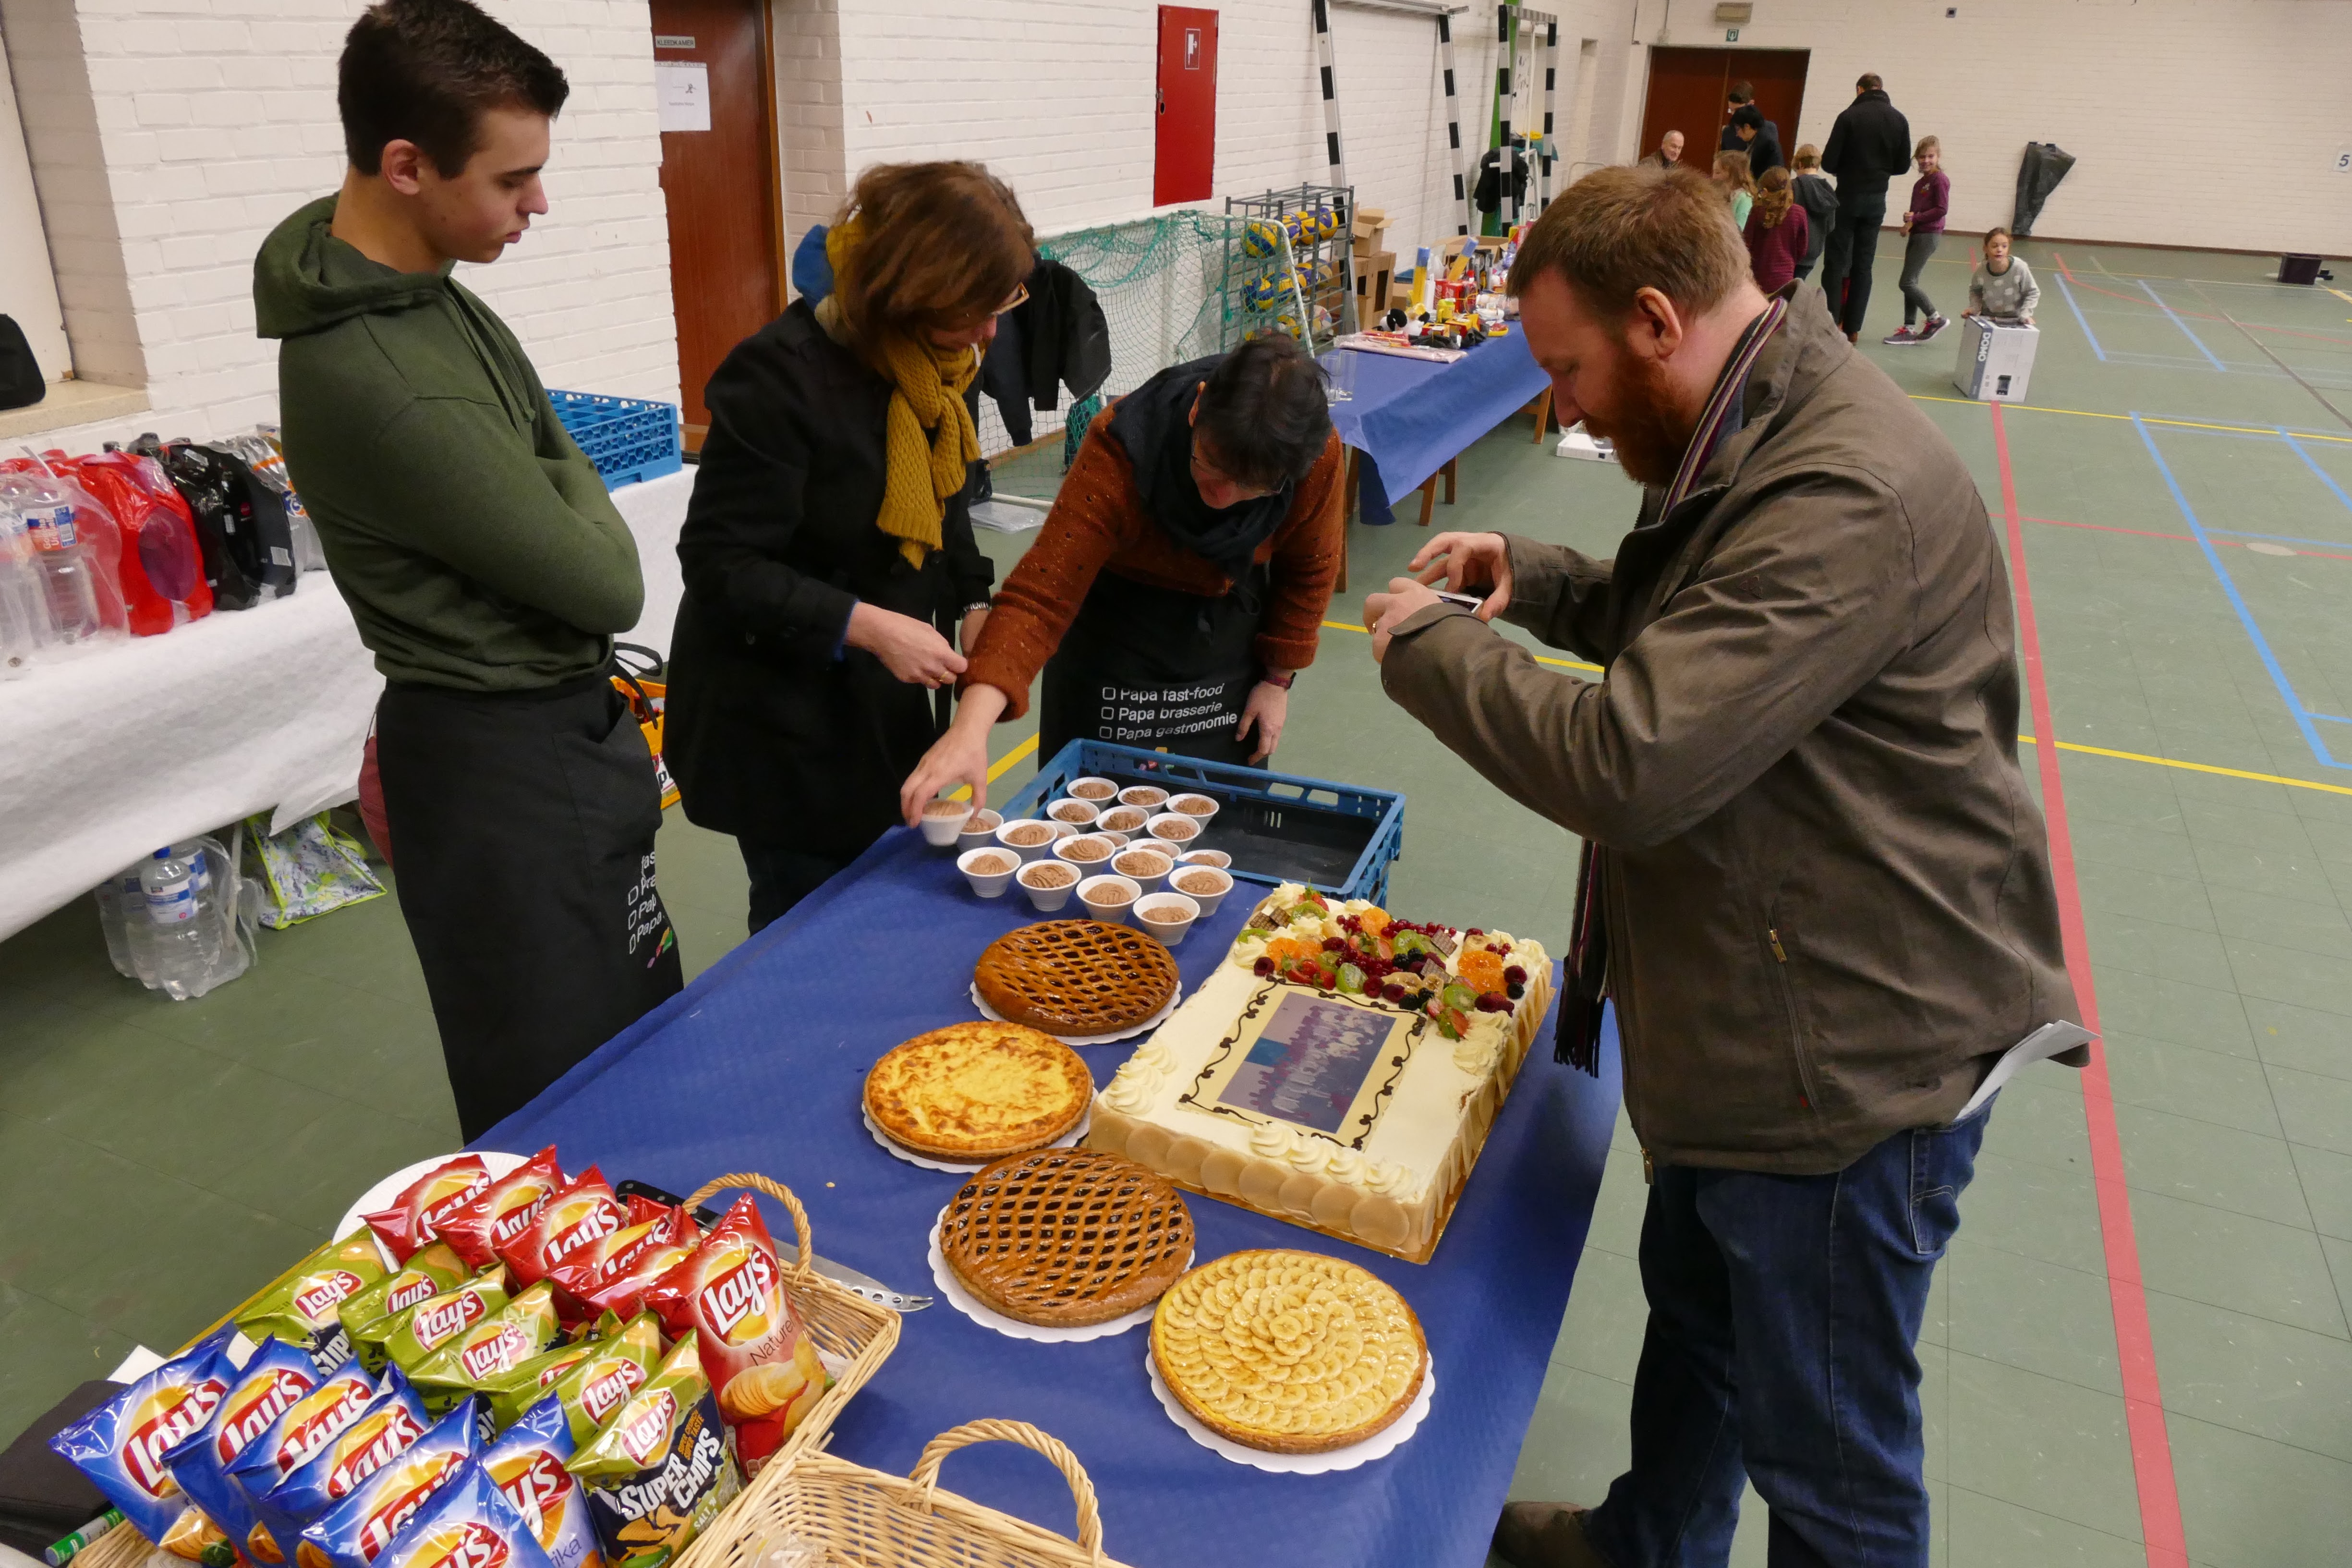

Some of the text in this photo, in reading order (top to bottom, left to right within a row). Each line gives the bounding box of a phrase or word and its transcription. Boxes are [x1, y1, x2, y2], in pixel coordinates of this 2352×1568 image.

[2339, 155, 2350, 167] 5
[1978, 332, 1991, 362] DOMO
[1118, 701, 1223, 722] Papa brasserie
[1120, 682, 1225, 704] Papa fast-food
[1116, 712, 1237, 740] Papa gastronomie
[299, 1273, 353, 1317] Lay's
[704, 1251, 770, 1335] Lay's
[421, 1294, 476, 1345] Lay's
[465, 1328, 518, 1379] Lay's
[585, 1363, 636, 1419] Lay's
[626, 1394, 671, 1460] Lay's
[619, 1453, 687, 1521] SUPER
[673, 1427, 720, 1508] CHIPS
[693, 1506, 711, 1527] SALT
